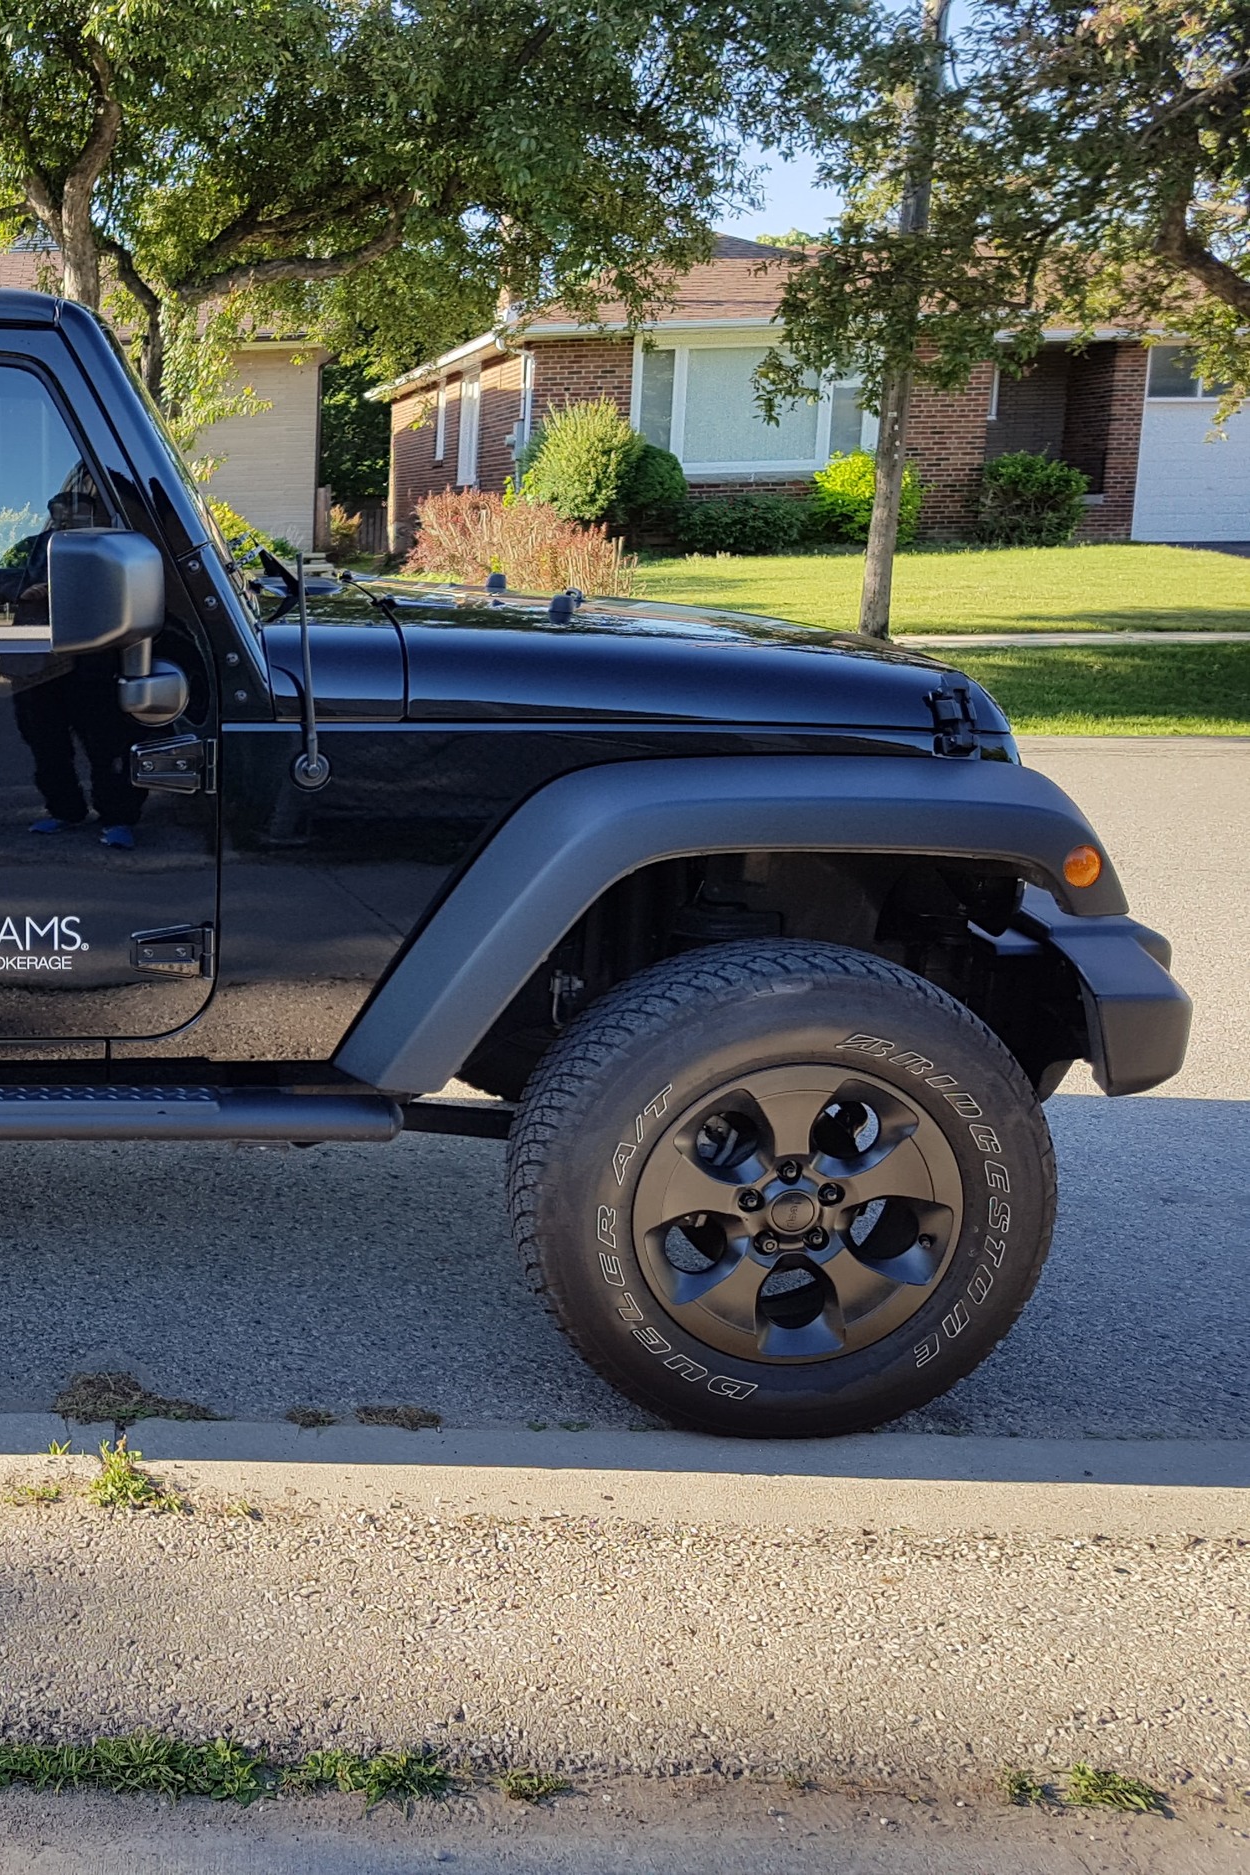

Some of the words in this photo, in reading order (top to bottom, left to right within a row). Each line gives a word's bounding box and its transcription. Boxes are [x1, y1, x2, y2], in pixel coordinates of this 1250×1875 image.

[611, 1083, 674, 1186] A/T
[835, 1033, 1011, 1369] BRIDGESTONE
[596, 1204, 759, 1400] DUELER
